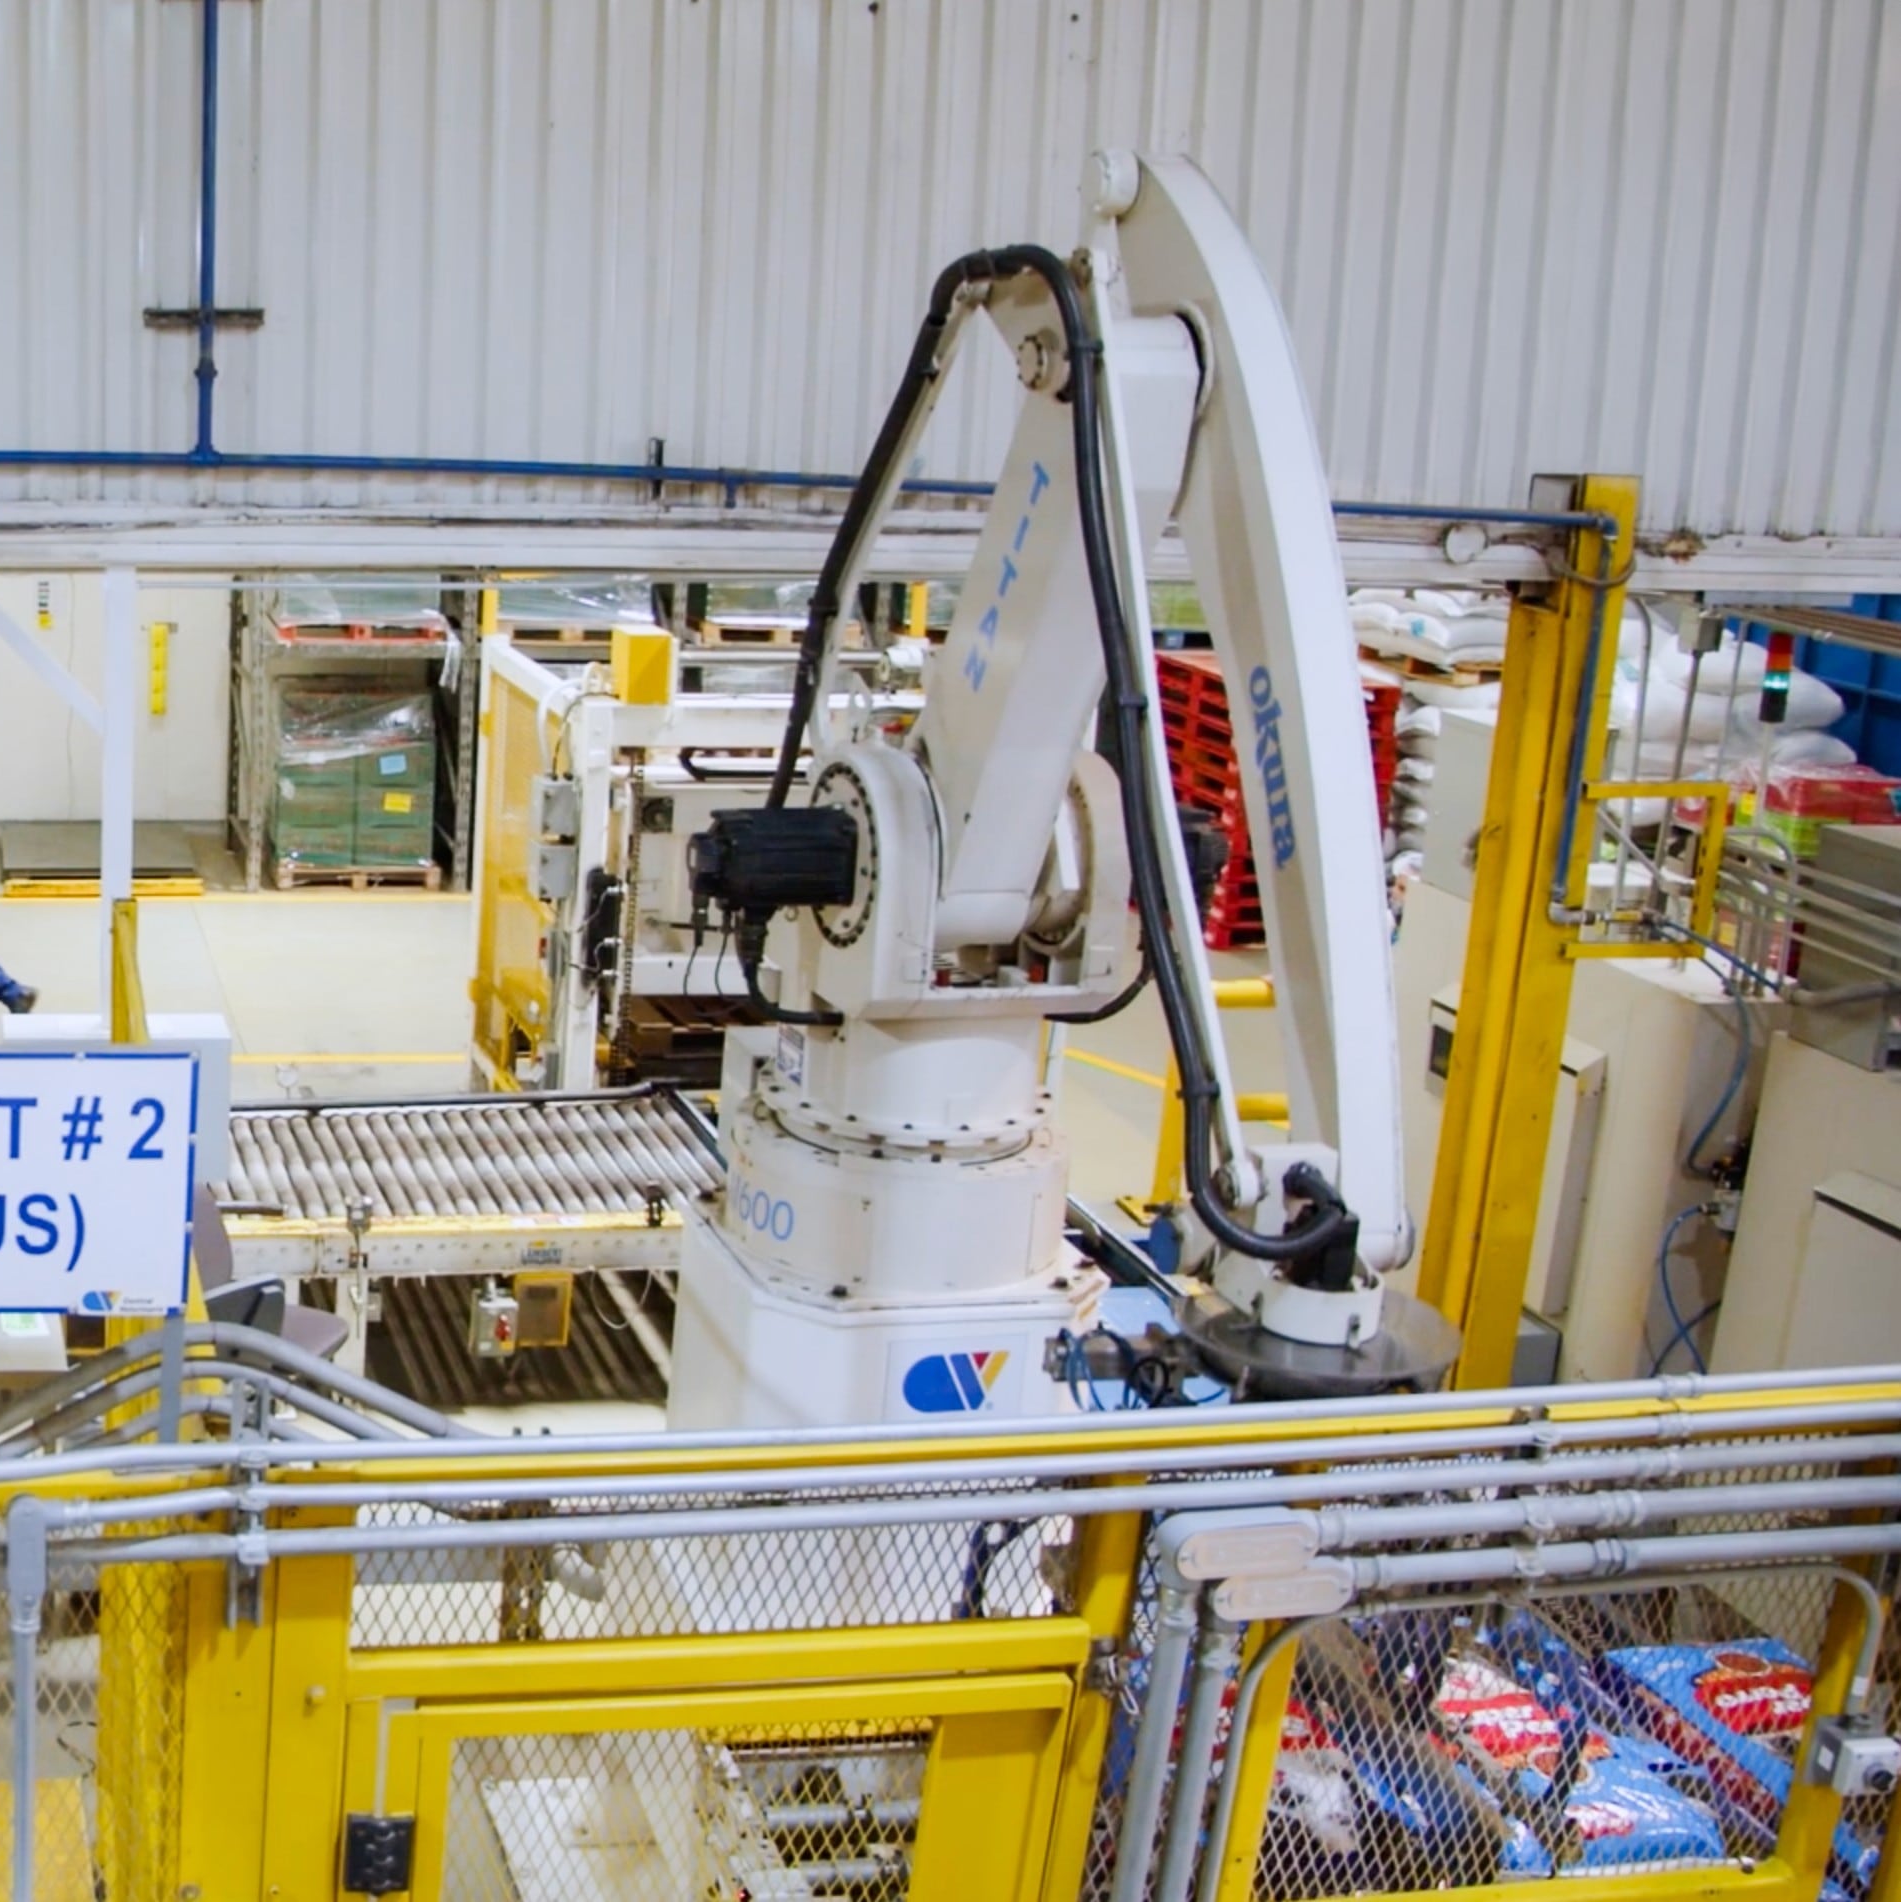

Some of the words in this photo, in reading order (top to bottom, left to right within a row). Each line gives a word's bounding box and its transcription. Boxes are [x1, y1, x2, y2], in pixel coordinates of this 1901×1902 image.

[964, 461, 1050, 692] TITAN
[1250, 665, 1296, 869] okura
[61, 1096, 104, 1161] #
[127, 1097, 166, 1160] 2
